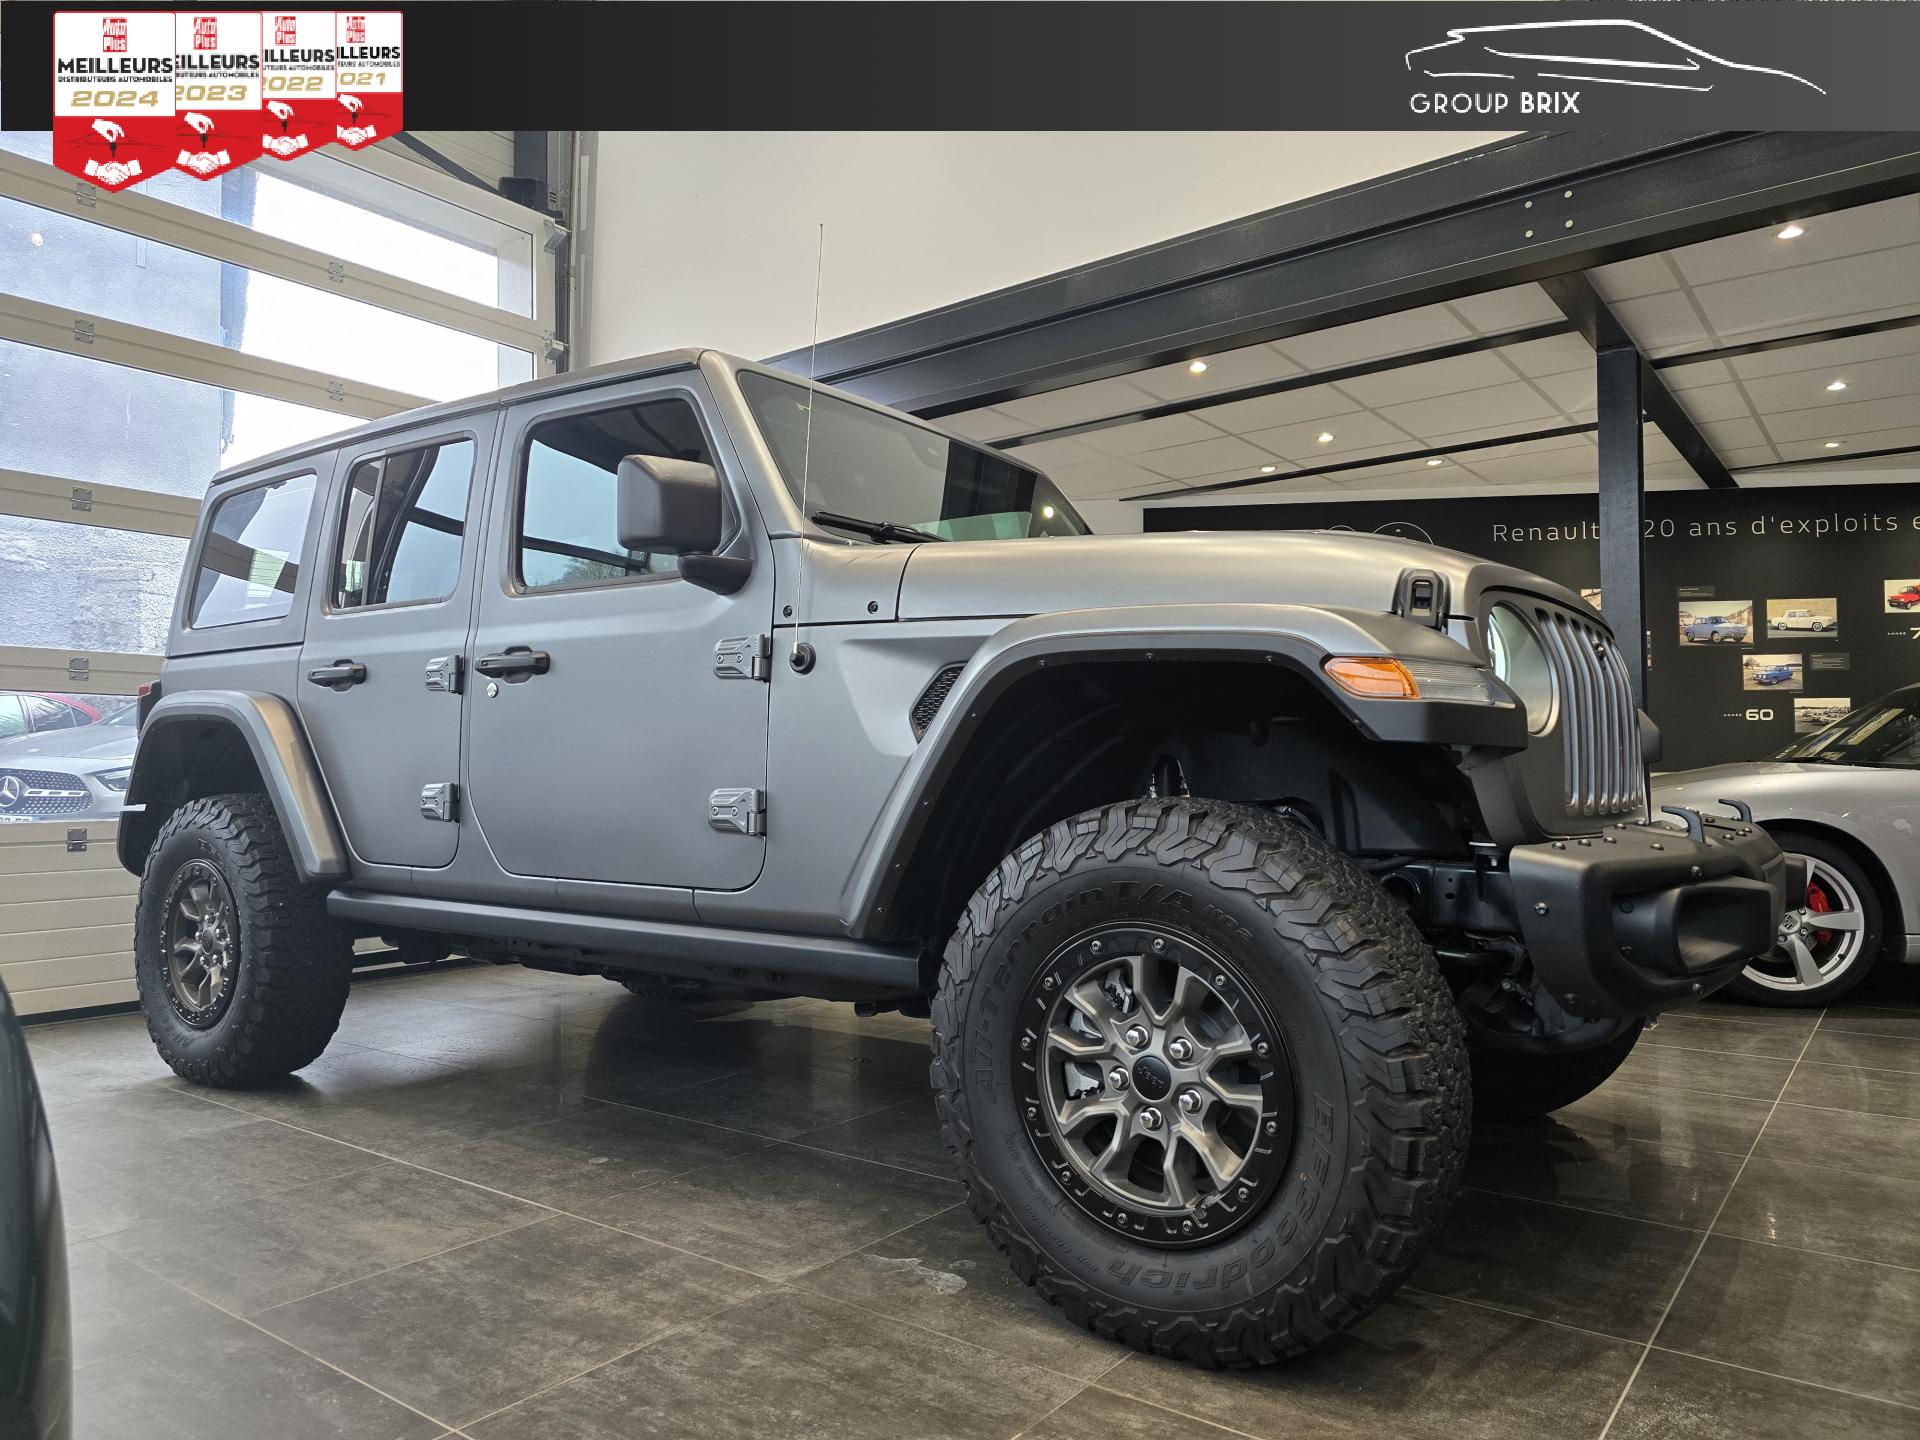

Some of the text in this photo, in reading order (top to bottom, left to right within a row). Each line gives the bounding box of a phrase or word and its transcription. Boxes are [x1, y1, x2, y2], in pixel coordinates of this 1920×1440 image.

[1493, 520, 1600, 542] Renault
[1689, 520, 1737, 537] ans
[1751, 513, 1898, 538] d'exploits
[1745, 709, 1774, 721] 60
[1112, 880, 1193, 912] T/A
